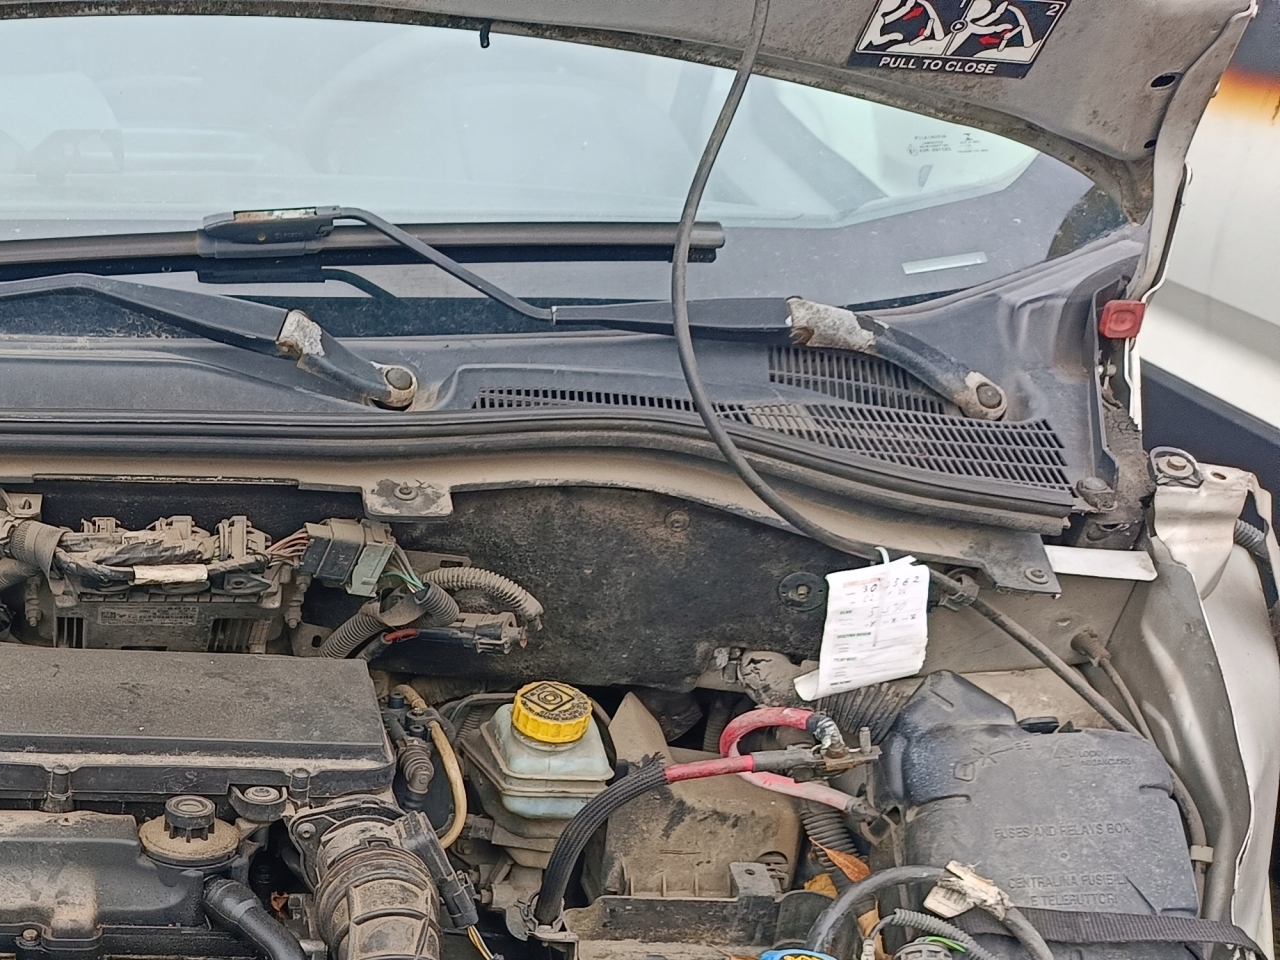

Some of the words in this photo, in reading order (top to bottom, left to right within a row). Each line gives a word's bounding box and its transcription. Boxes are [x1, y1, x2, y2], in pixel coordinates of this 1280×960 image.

[1045, 4, 1060, 16] 2
[878, 56, 917, 70] PULL
[922, 59, 942, 71] TO
[944, 61, 998, 75] CLOSE
[994, 826, 1031, 839] FUSES
[1034, 825, 1057, 837] AND
[1060, 823, 1103, 836] RELAYS
[1107, 822, 1131, 834] BOX
[1008, 874, 1078, 889] CENTRALINA
